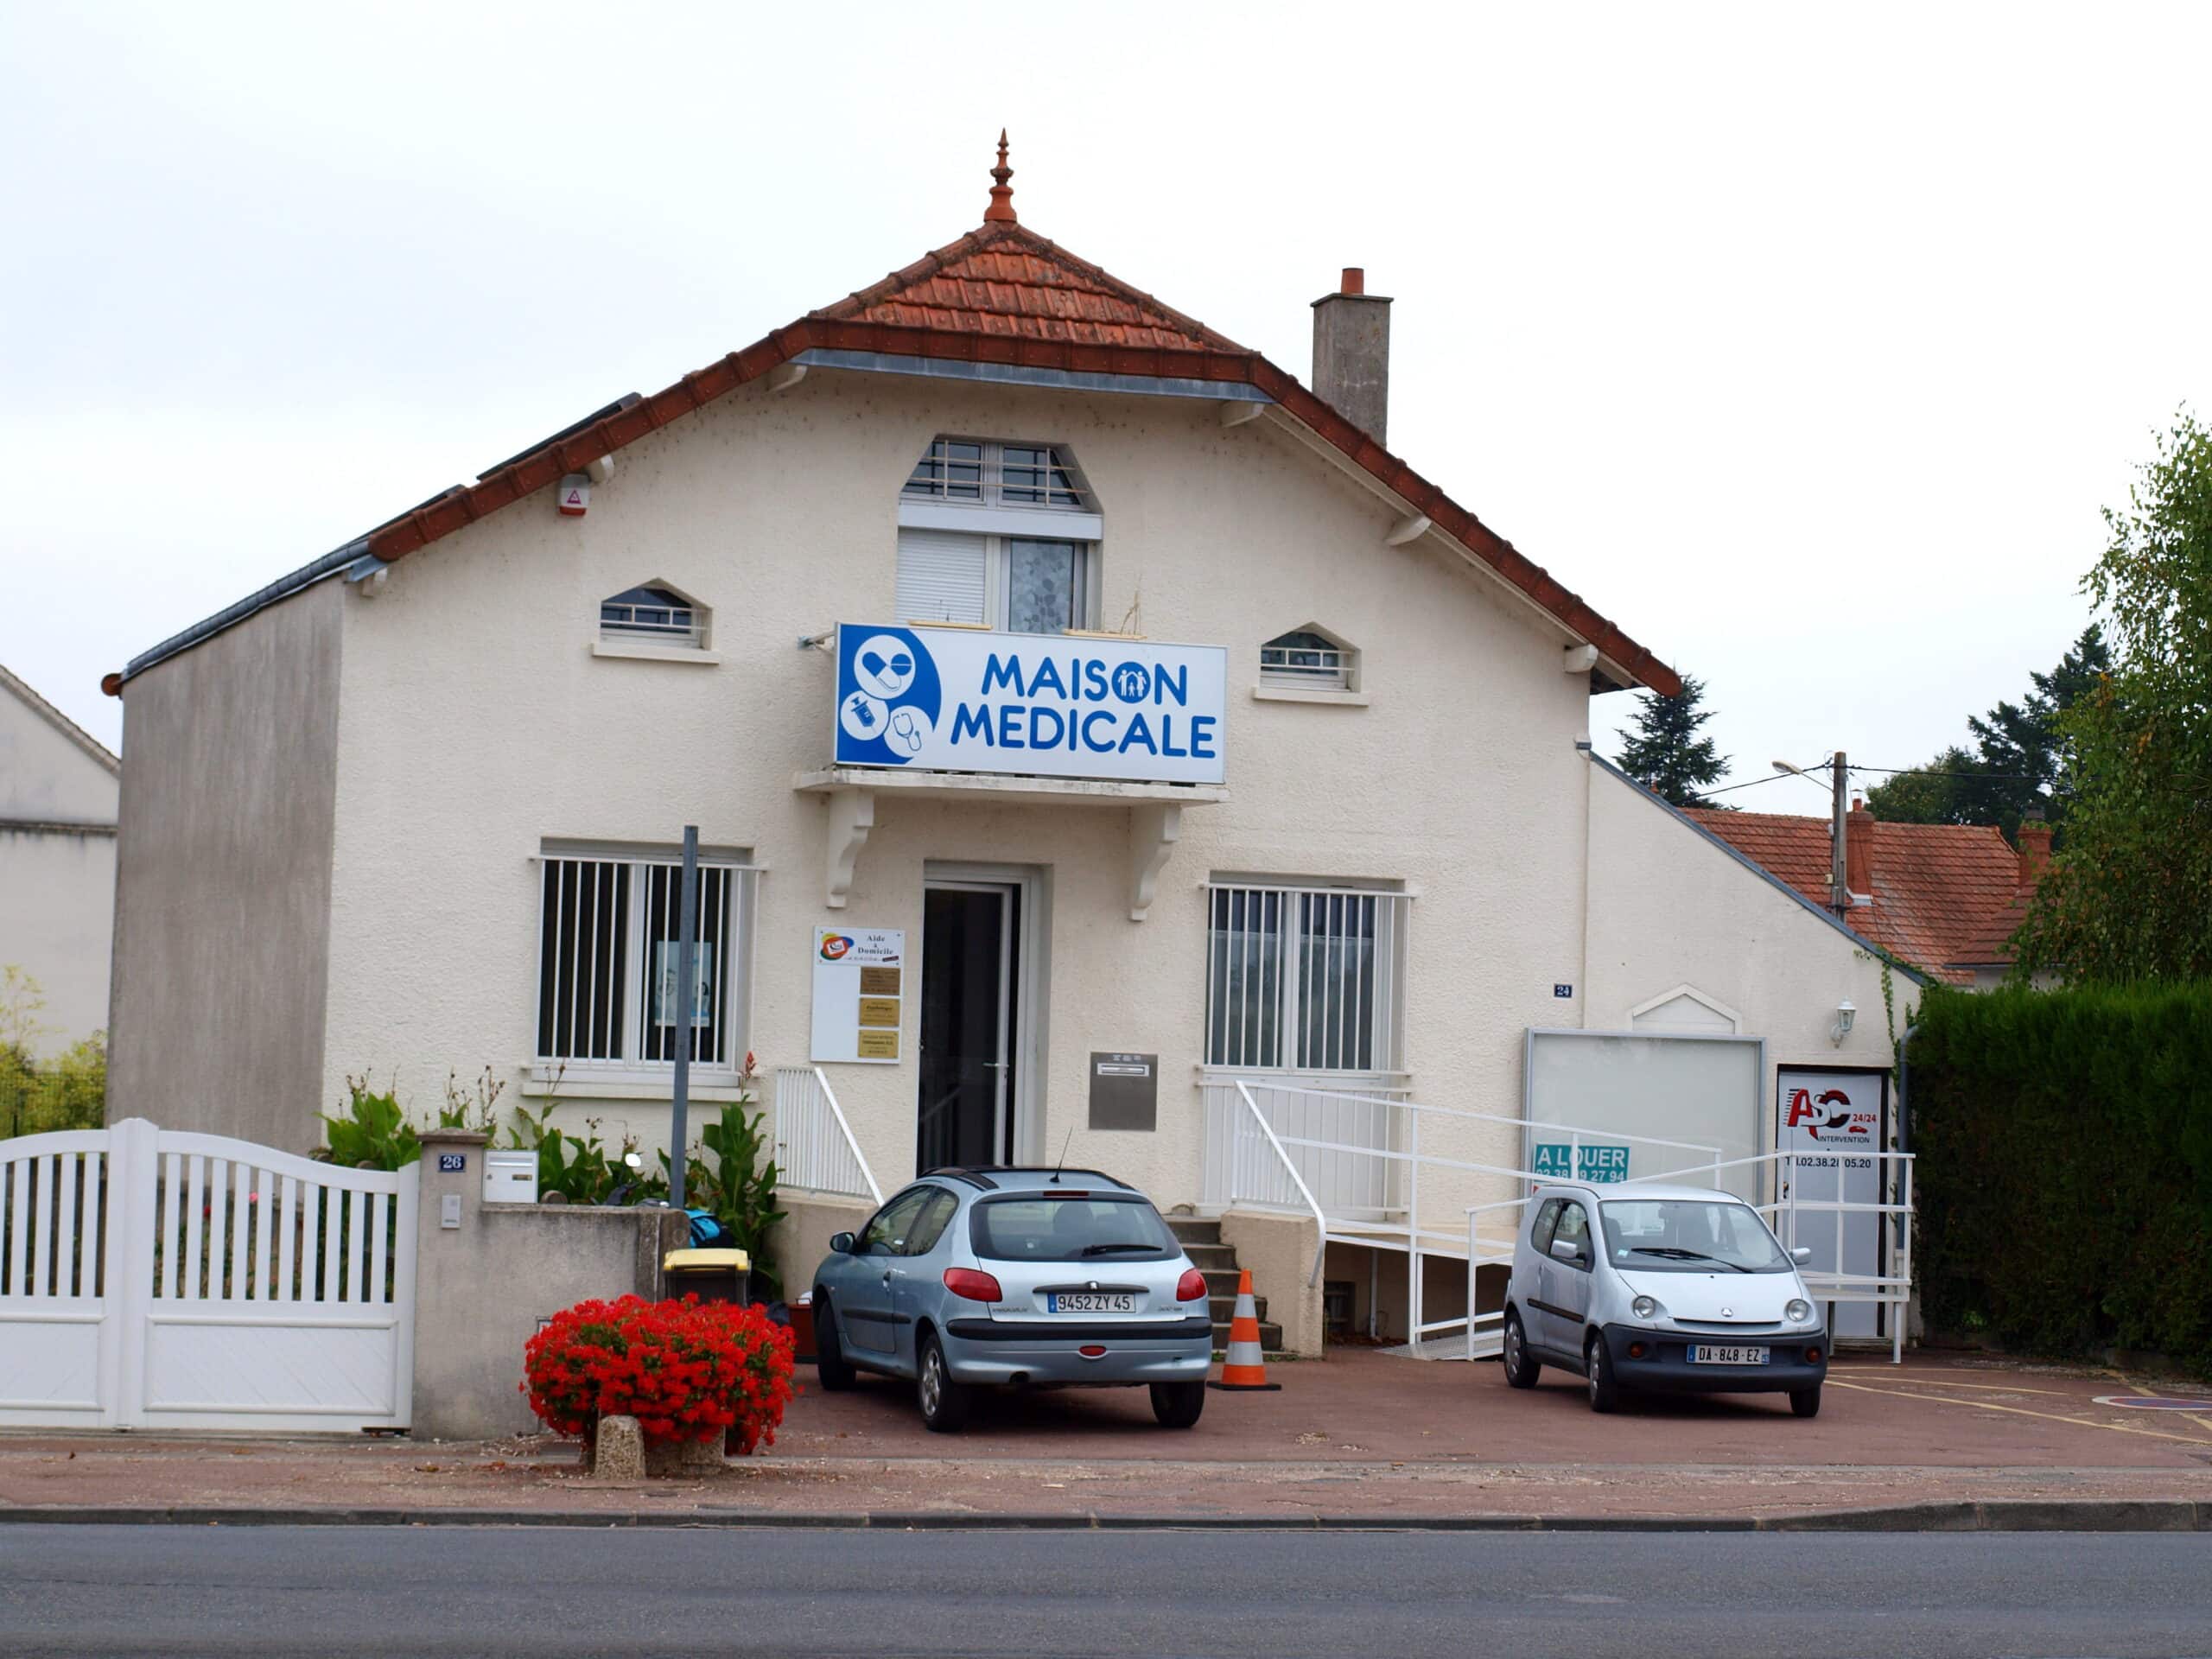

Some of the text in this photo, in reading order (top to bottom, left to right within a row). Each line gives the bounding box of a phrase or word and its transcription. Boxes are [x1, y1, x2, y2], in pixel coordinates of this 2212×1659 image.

[981, 653, 1188, 707] MAISON
[950, 702, 1217, 759] MEDICALE
[858, 946, 893, 955] Domicile
[1557, 986, 1570, 995] 24
[1853, 1113, 1877, 1122] 24/24
[442, 1156, 462, 1169] 26
[1537, 1147, 1626, 1167] A LOUER
[1591, 1170, 1605, 1182] 27
[1610, 1171, 1624, 1182] 94
[1058, 1296, 1130, 1310] 9452 ZY 45
